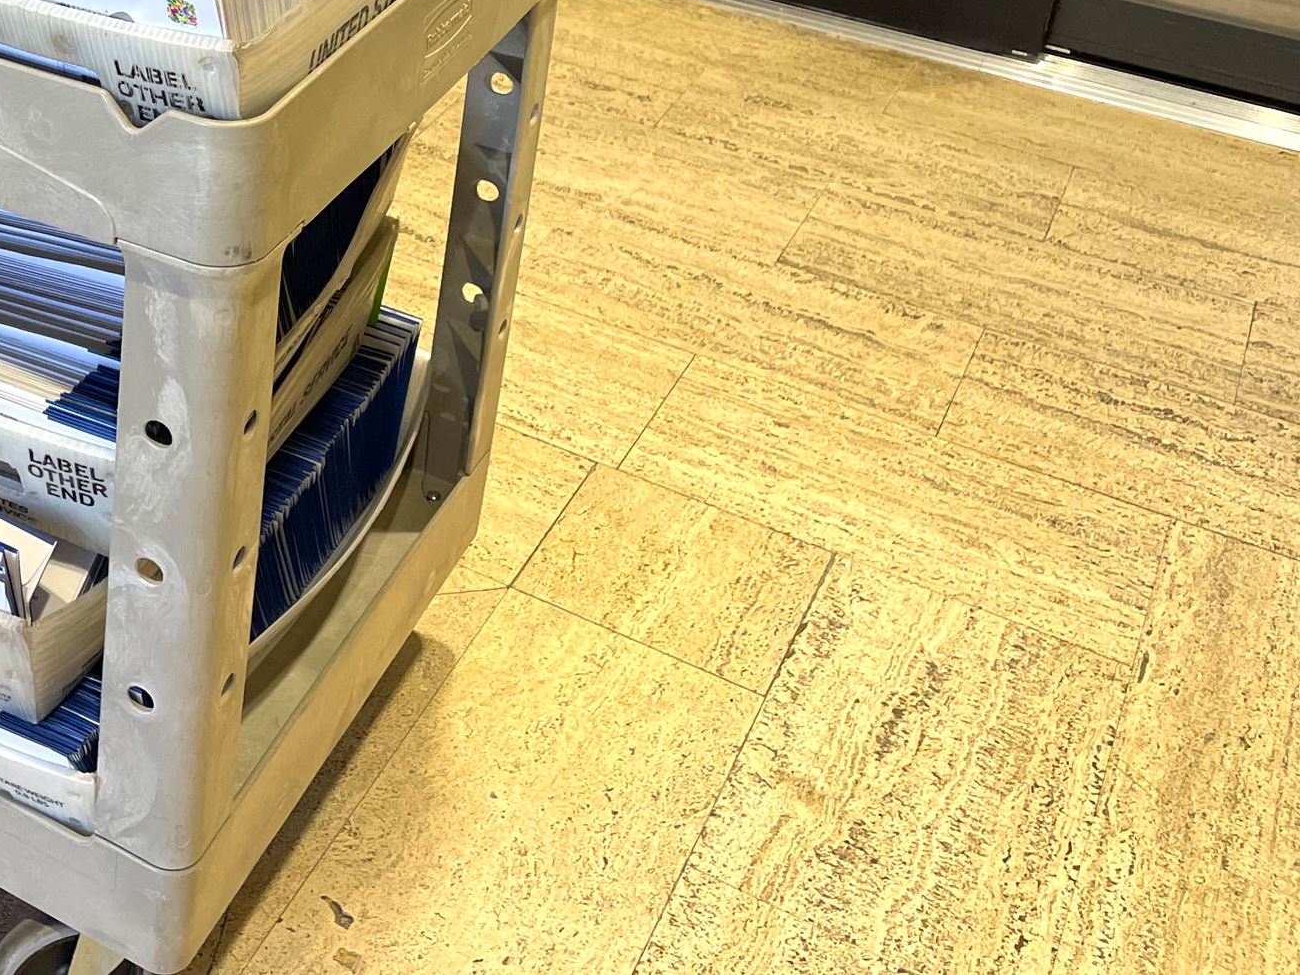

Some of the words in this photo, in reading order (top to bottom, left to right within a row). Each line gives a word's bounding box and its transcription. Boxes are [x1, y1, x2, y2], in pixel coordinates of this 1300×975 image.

[308, 4, 370, 75] UNITED
[114, 60, 197, 91] LABEL
[118, 81, 205, 112] OTHER
[28, 448, 105, 483] LABEL
[28, 465, 108, 497] OTHER
[47, 482, 94, 507] END
